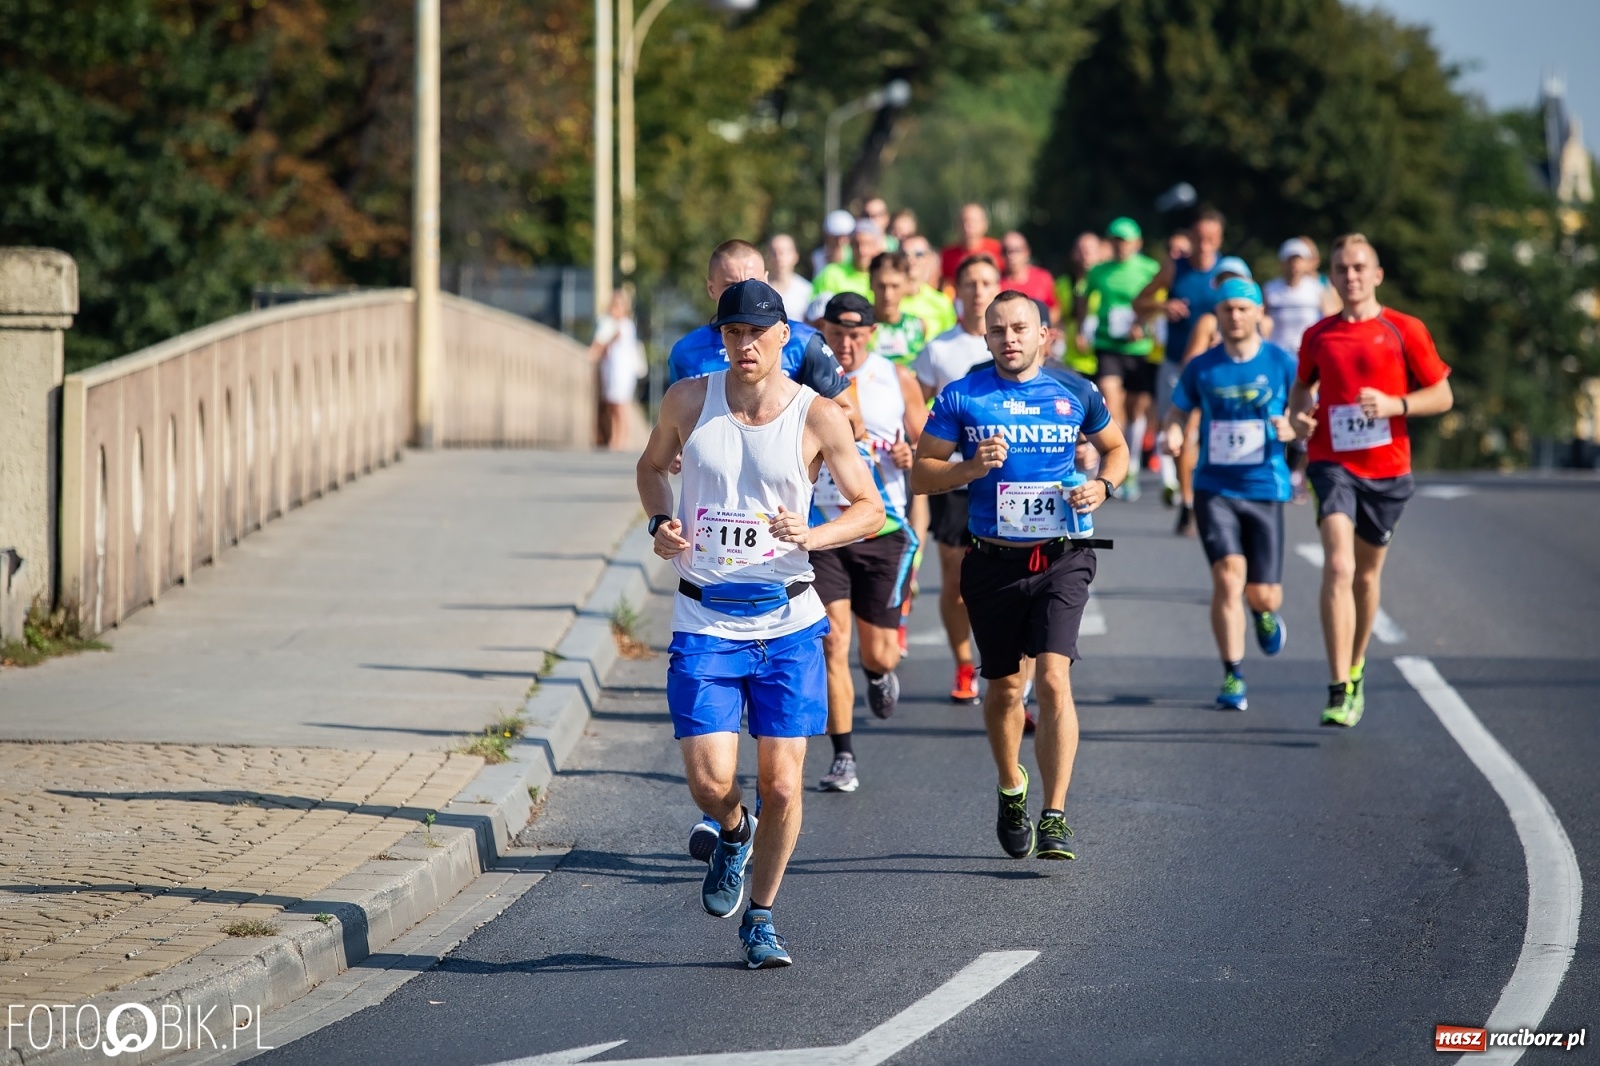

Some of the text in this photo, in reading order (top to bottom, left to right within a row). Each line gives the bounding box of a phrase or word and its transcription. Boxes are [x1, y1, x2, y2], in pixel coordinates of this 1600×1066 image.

[1010, 446, 1065, 454] OKNA TEAM
[1023, 498, 1056, 516] 134
[719, 525, 757, 548] 118
